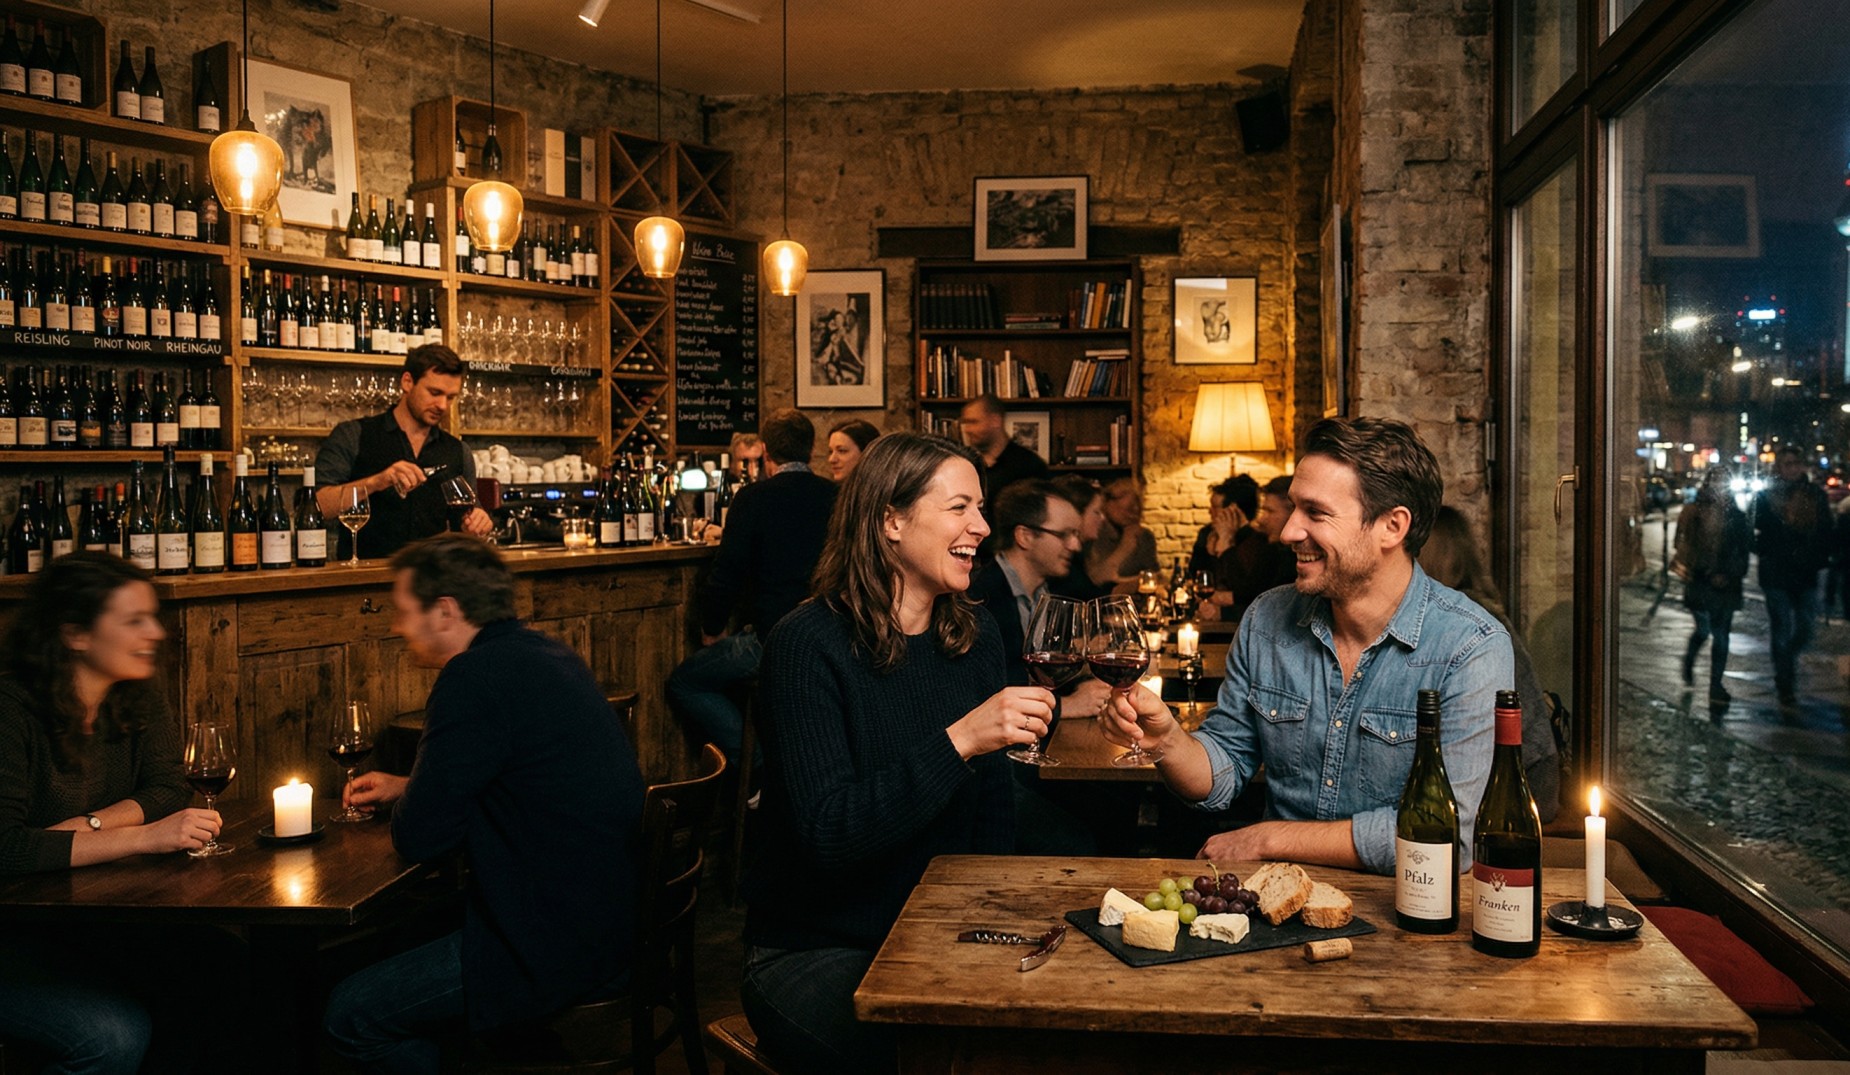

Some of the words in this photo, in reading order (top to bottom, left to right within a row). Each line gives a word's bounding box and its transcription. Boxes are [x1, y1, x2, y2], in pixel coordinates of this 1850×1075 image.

[14, 332, 71, 346] REISLING
[94, 337, 123, 350] PINOT
[127, 339, 152, 351] NOIR
[166, 342, 222, 355] RHEINGAU
[1404, 869, 1435, 885] Pfalz
[1478, 895, 1521, 912] Franken
